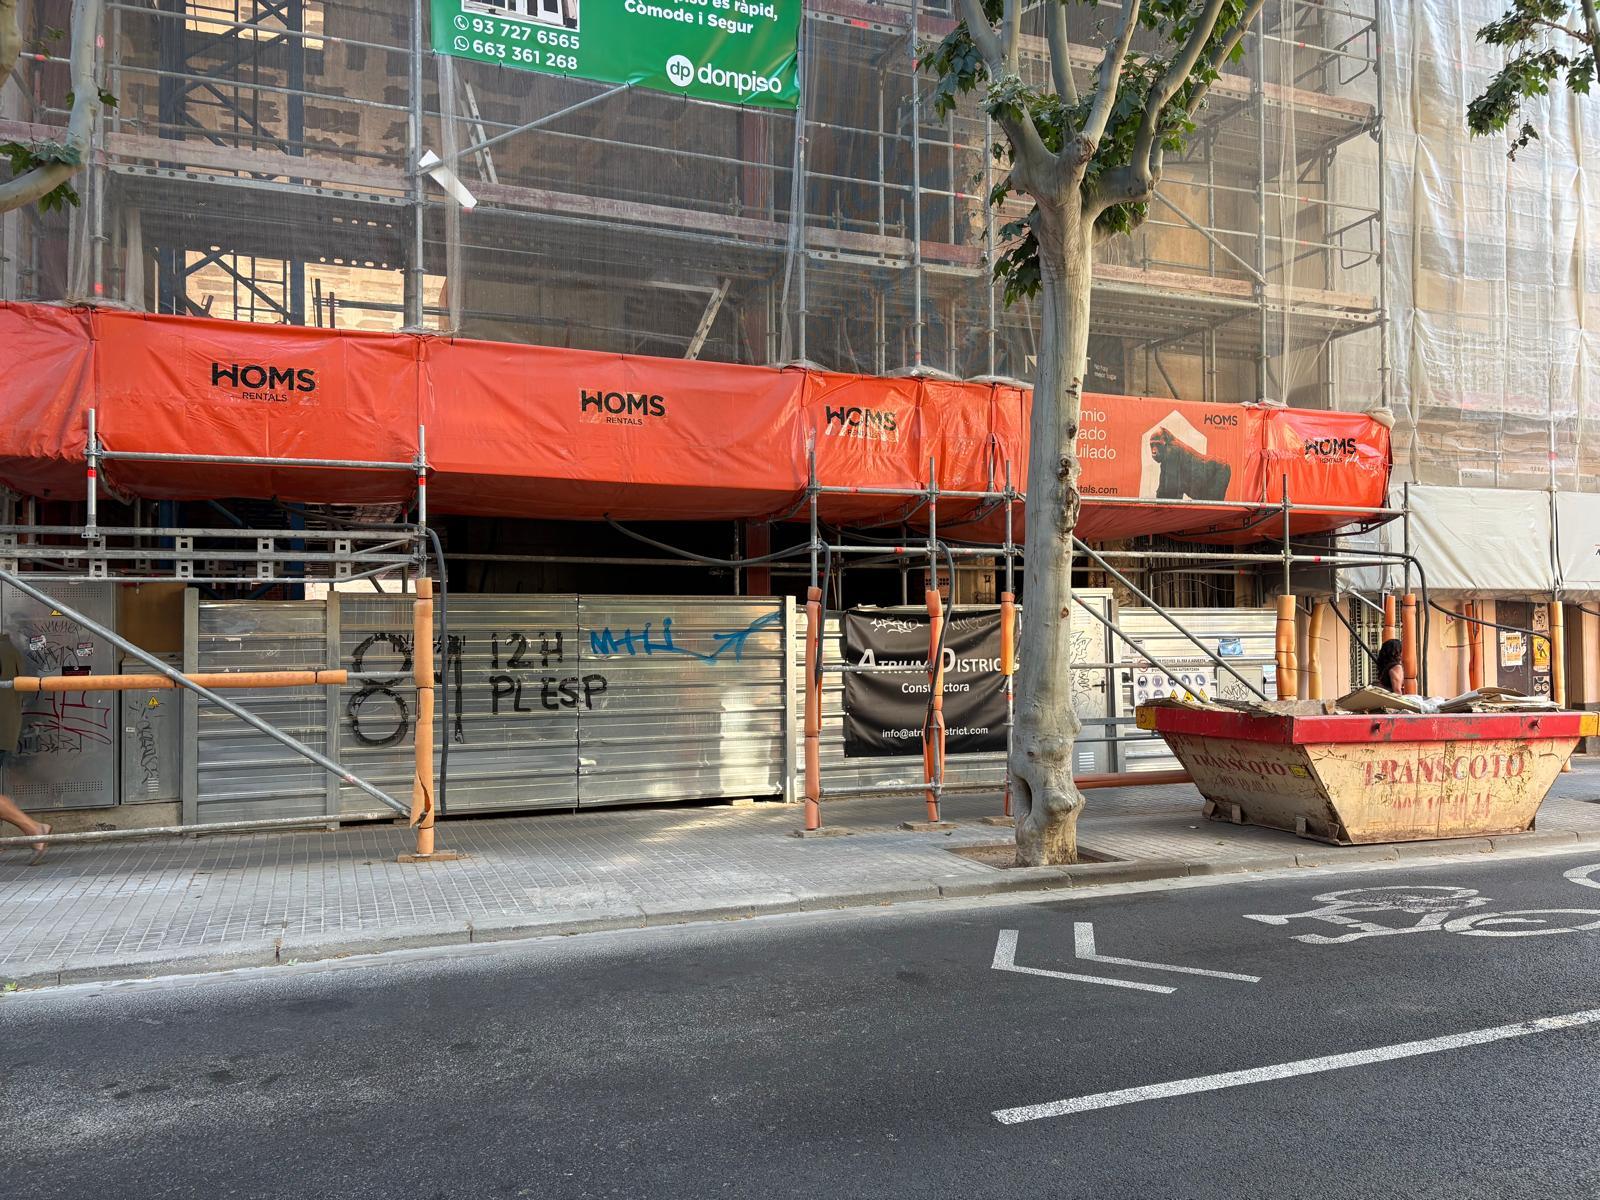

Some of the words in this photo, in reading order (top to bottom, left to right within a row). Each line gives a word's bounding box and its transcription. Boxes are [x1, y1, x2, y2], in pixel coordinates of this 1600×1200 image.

[624, 0, 694, 23] Còmode
[698, 12, 703, 25] i
[707, 13, 753, 34] Segur
[734, 0, 778, 21] ràpid,
[472, 18, 494, 35] 93
[500, 23, 531, 41] 727
[537, 30, 580, 50] 6565
[473, 39, 506, 58] 663
[512, 46, 540, 64] 361
[545, 52, 578, 70] 268
[670, 61, 691, 80] dp
[697, 63, 782, 95] donpiso
[211, 362, 316, 392] HOMS
[242, 391, 288, 402] RENTALS
[581, 390, 666, 417] HOMS
[606, 416, 643, 425] RENTALS
[825, 406, 897, 431] HOMS
[1079, 408, 1106, 422] mio
[1204, 414, 1238, 426] HOMS
[1076, 426, 1107, 440] ado
[1076, 444, 1117, 459] uilado
[1304, 438, 1357, 456] HOMS
[1077, 485, 1118, 494] tals.com
[941, 647, 1003, 674] DISTRIC
[901, 683, 970, 693] Constctora
[1362, 751, 1526, 788] TRANSCOTO
